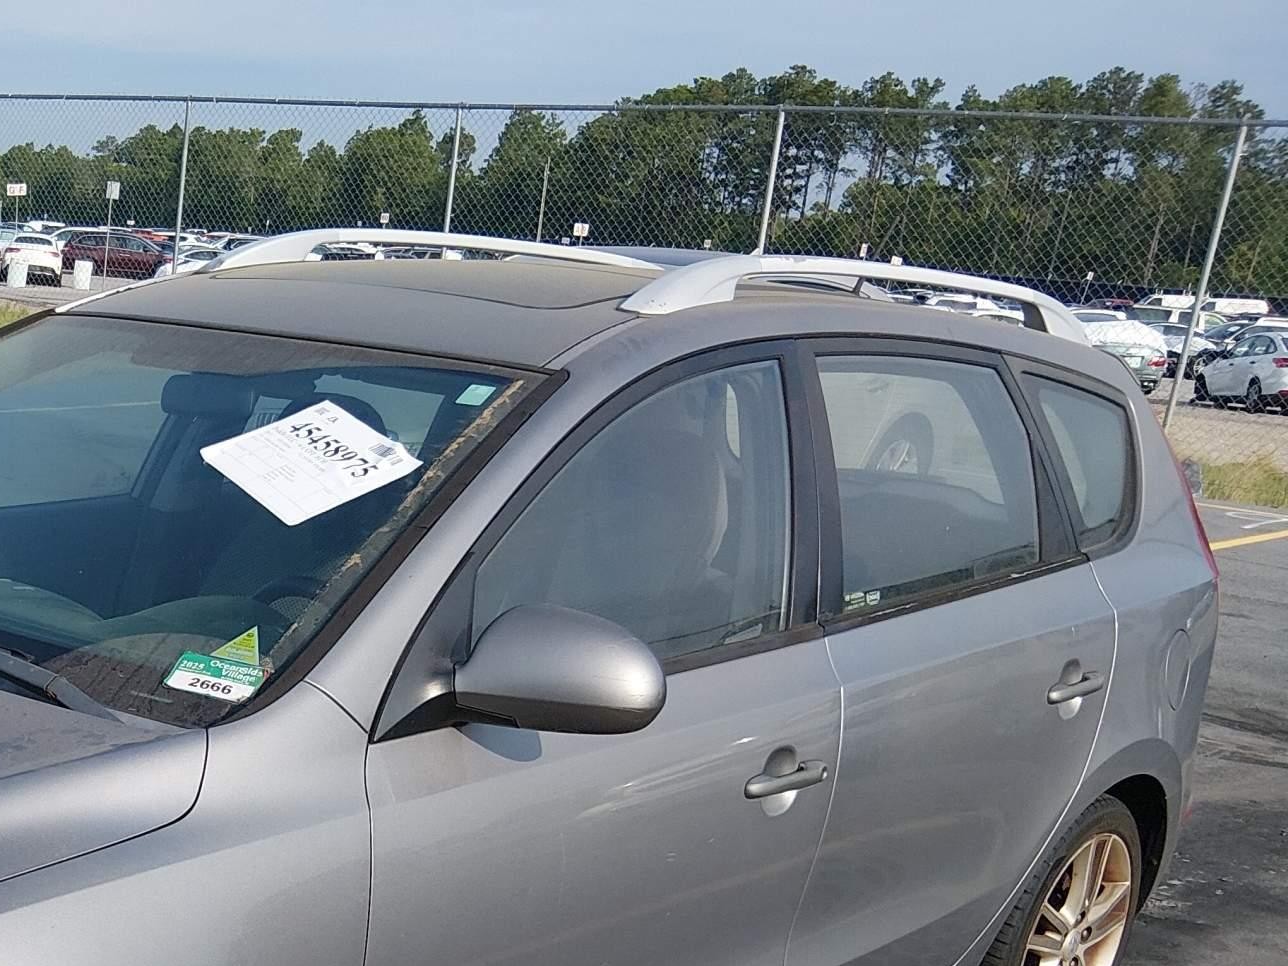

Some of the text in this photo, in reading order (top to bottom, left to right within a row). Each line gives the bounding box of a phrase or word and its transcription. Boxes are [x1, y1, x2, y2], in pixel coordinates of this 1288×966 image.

[290, 422, 379, 478] 45458975
[180, 660, 206, 670] 2025
[222, 668, 256, 684] Village
[188, 677, 234, 695] 2666
